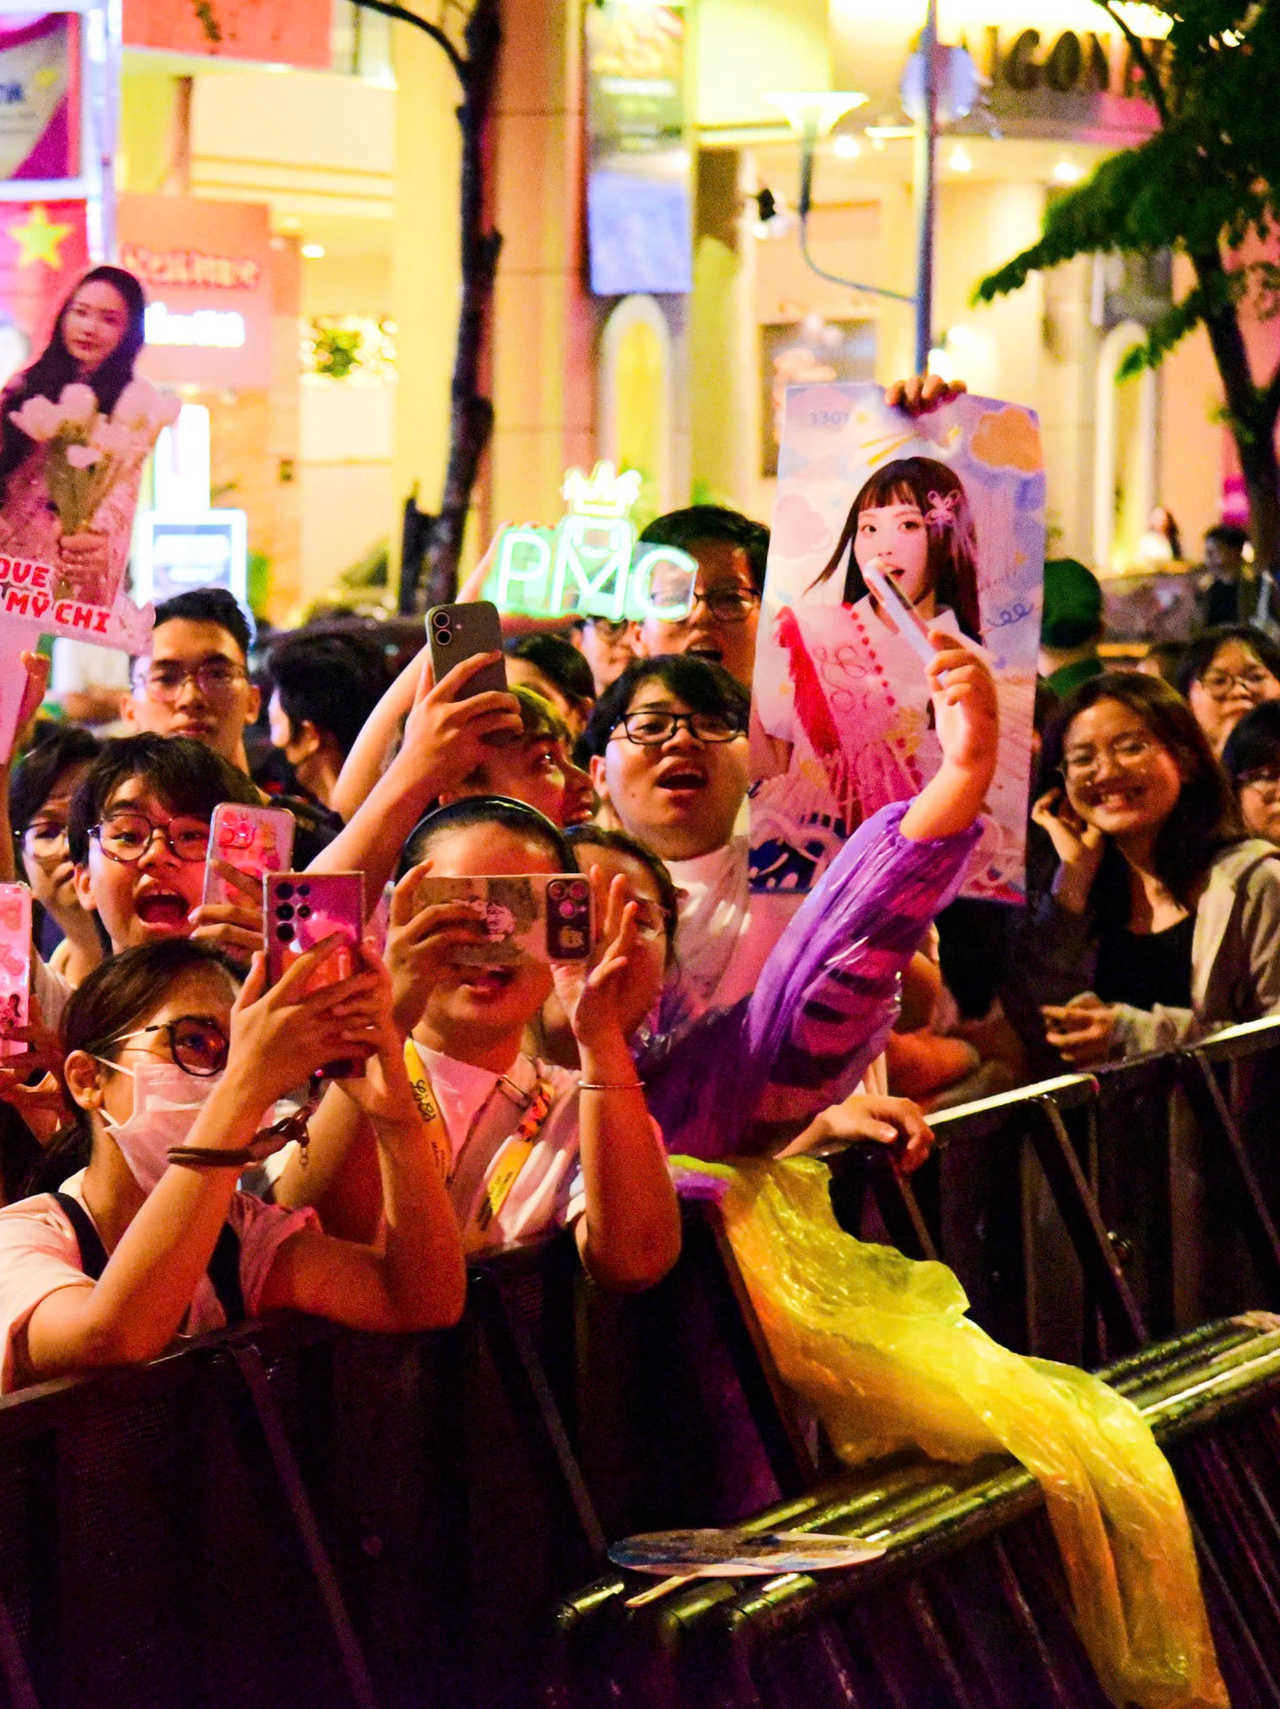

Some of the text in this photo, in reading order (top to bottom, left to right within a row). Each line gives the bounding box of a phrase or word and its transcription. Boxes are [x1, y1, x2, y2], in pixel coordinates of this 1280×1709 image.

[495, 516, 699, 621] PMC
[5, 591, 51, 618] MỸ
[54, 602, 111, 634] CHI
